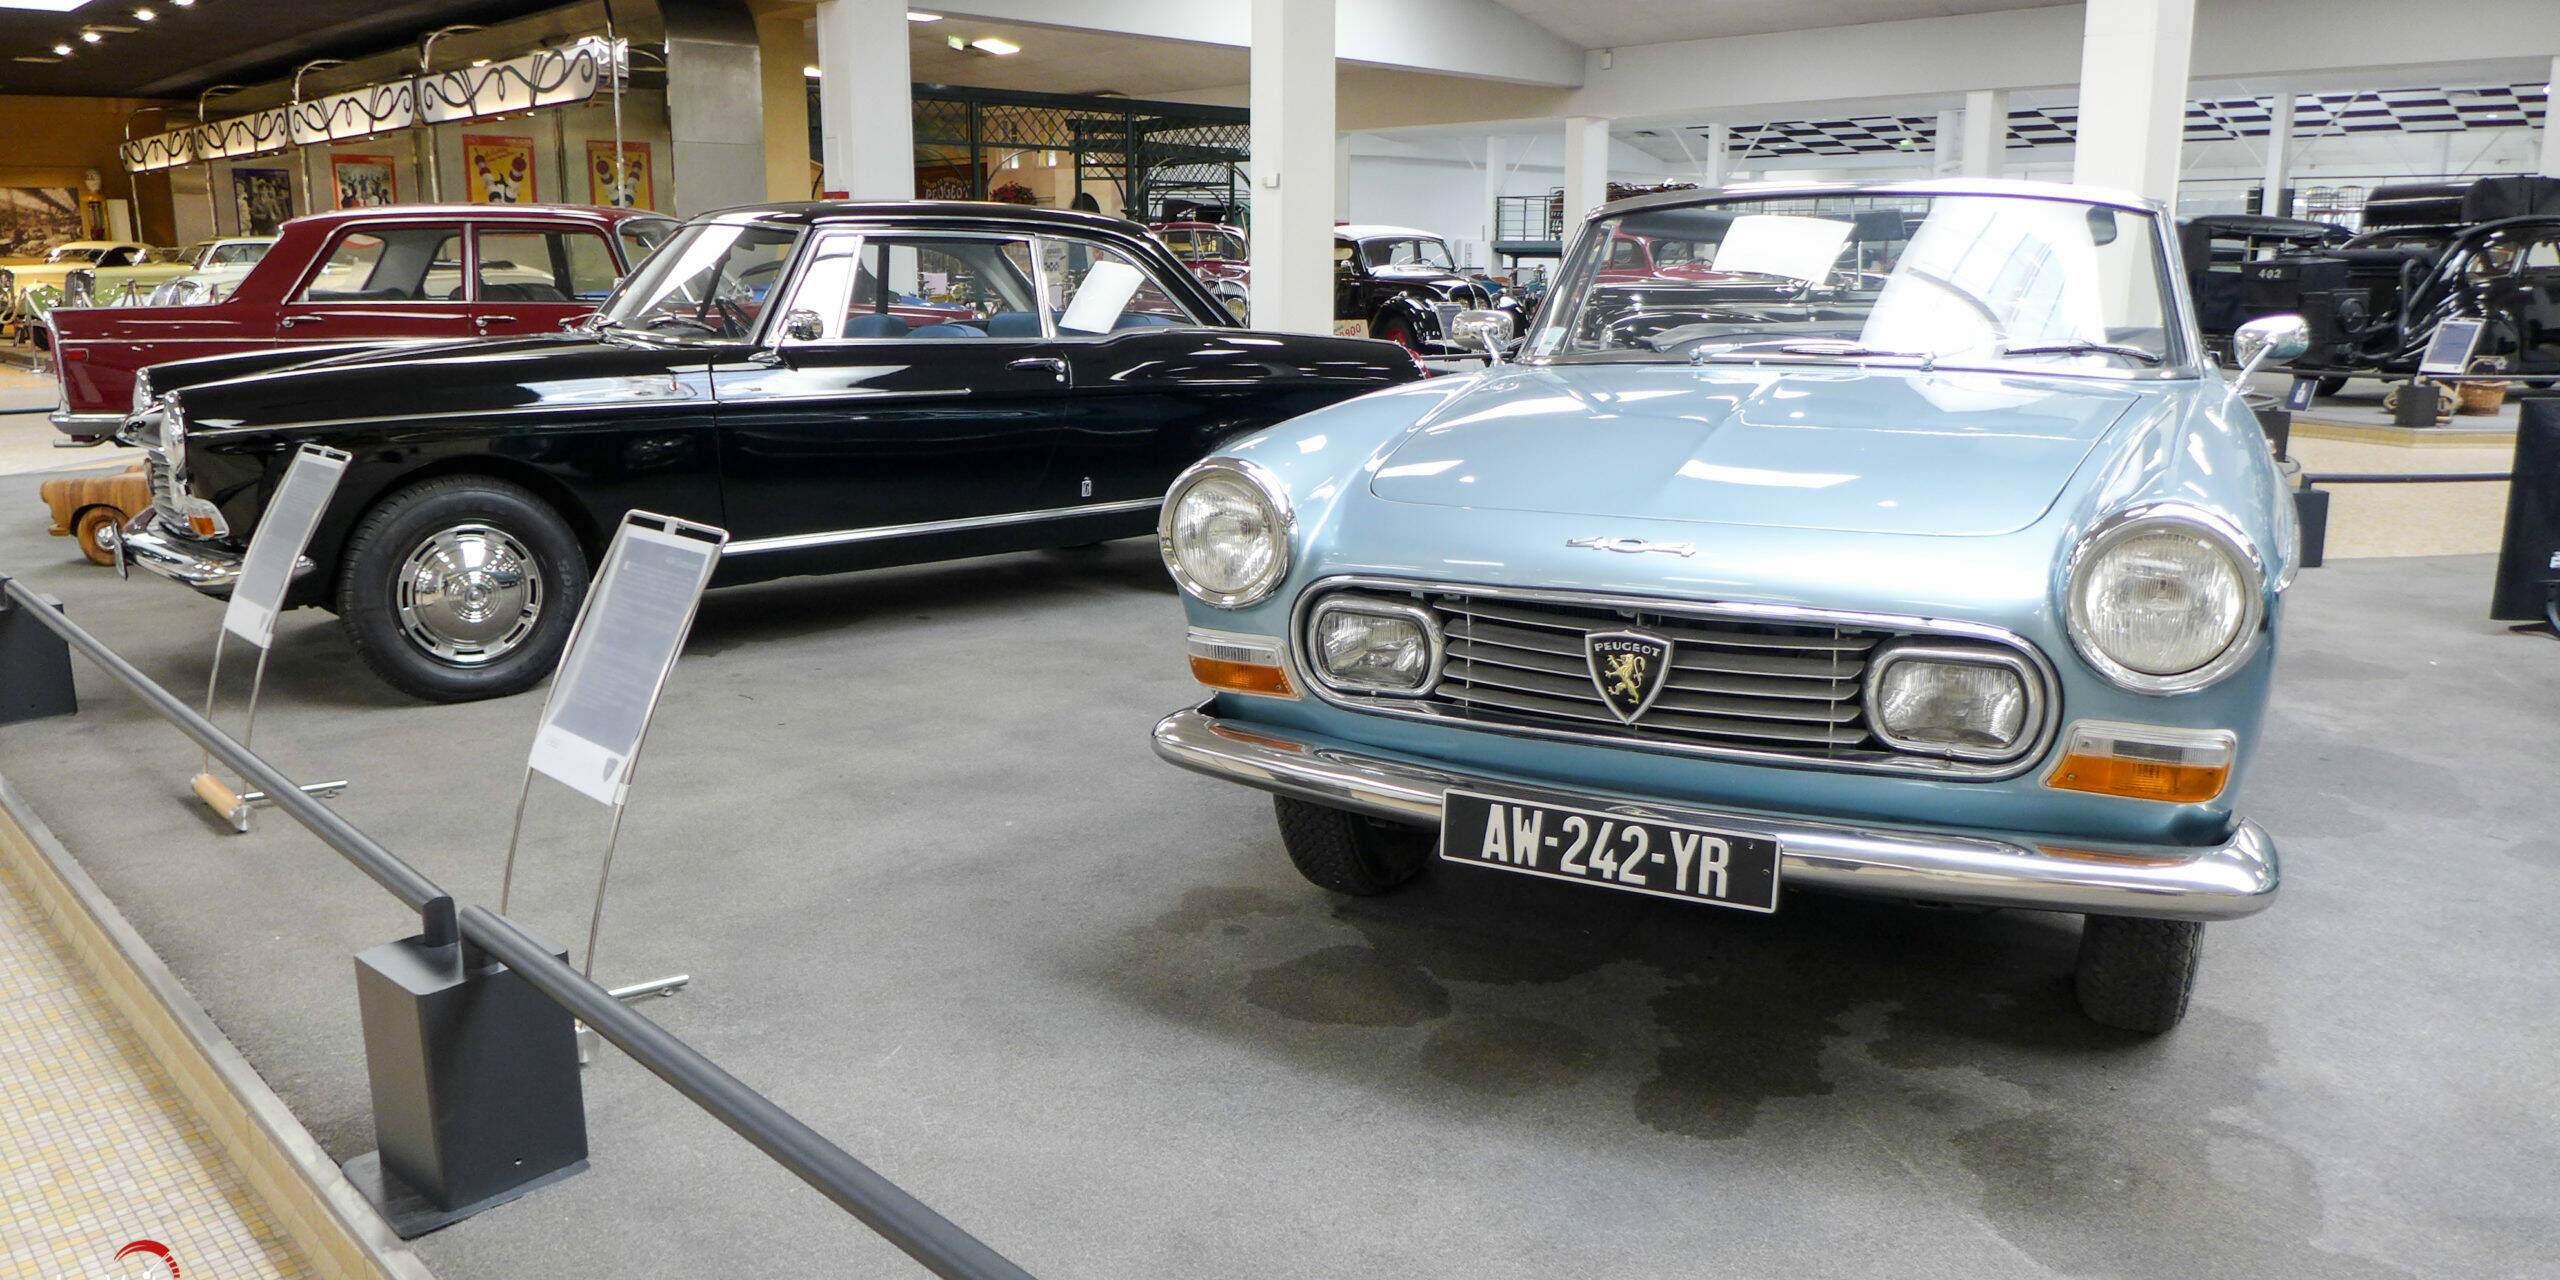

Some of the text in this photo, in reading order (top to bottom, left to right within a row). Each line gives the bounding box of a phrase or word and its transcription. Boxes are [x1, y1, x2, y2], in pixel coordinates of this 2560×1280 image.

[2258, 268, 2281, 279] 402
[1566, 536, 1697, 558] 404
[1594, 641, 1661, 658] PEUGEOT
[1481, 803, 1729, 899] AW-242-YR
